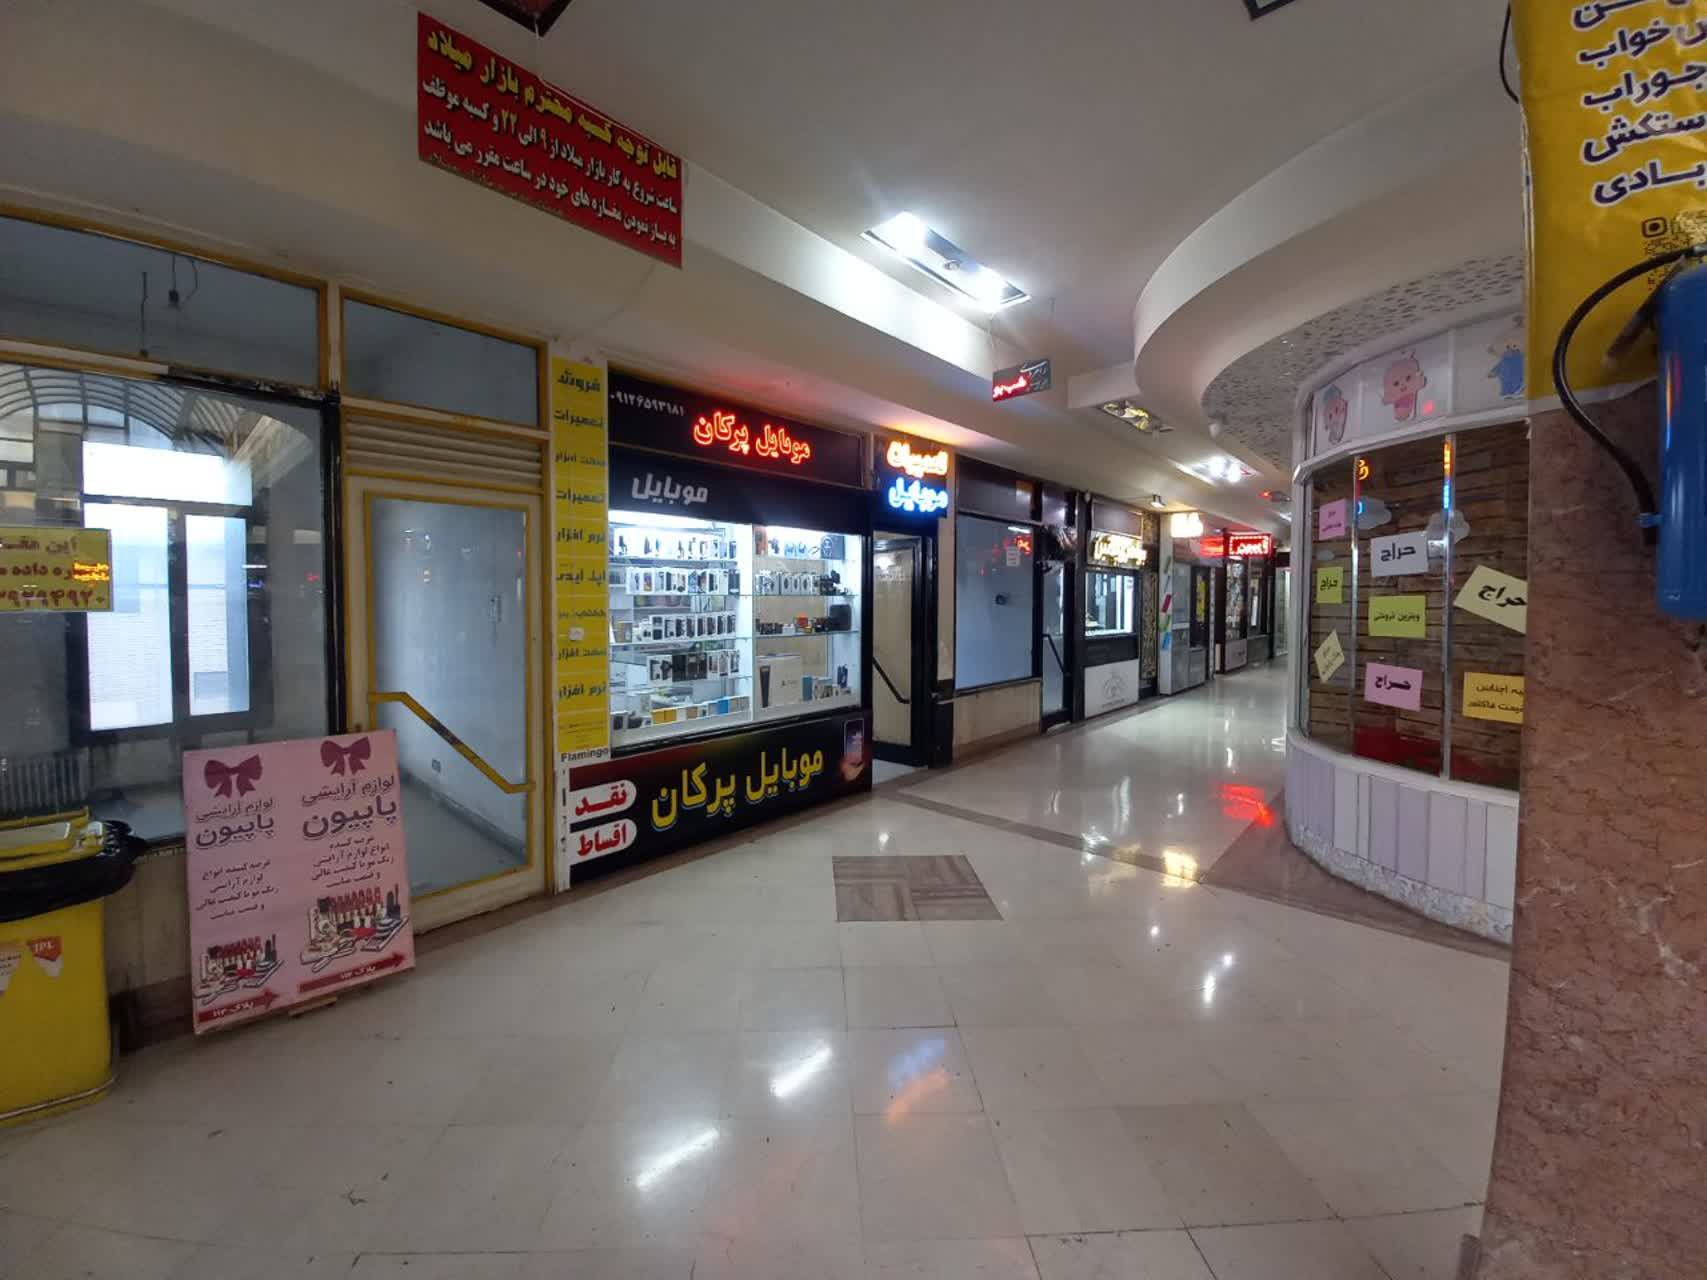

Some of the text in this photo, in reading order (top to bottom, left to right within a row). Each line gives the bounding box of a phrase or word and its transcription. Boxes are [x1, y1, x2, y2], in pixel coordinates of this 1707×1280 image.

[428, 31, 473, 71] میلاد
[1578, 20, 1671, 67] خواب
[480, 56, 519, 101] بازار
[1583, 64, 1707, 112] جوراب
[524, 84, 574, 124] محترم
[617, 135, 650, 166] توجه
[1584, 113, 1707, 163] ستکش
[653, 150, 679, 179] قابل
[693, 409, 812, 465] موبایل پرکان
[631, 473, 709, 505] موبایل
[1380, 541, 1417, 562] حراج
[1318, 576, 1339, 591] حراج
[1477, 582, 1526, 607] حراج
[1374, 672, 1412, 691] حراج
[561, 748, 609, 762] Flamingo
[302, 776, 395, 806] لوازم آرایشی
[575, 783, 628, 817] نقد
[651, 747, 825, 832] موبایل پرکان
[194, 797, 274, 824] لوازم آرایشی
[303, 795, 397, 838] پاپیون
[196, 813, 275, 847] پاپیون
[577, 822, 627, 857] اقساط
